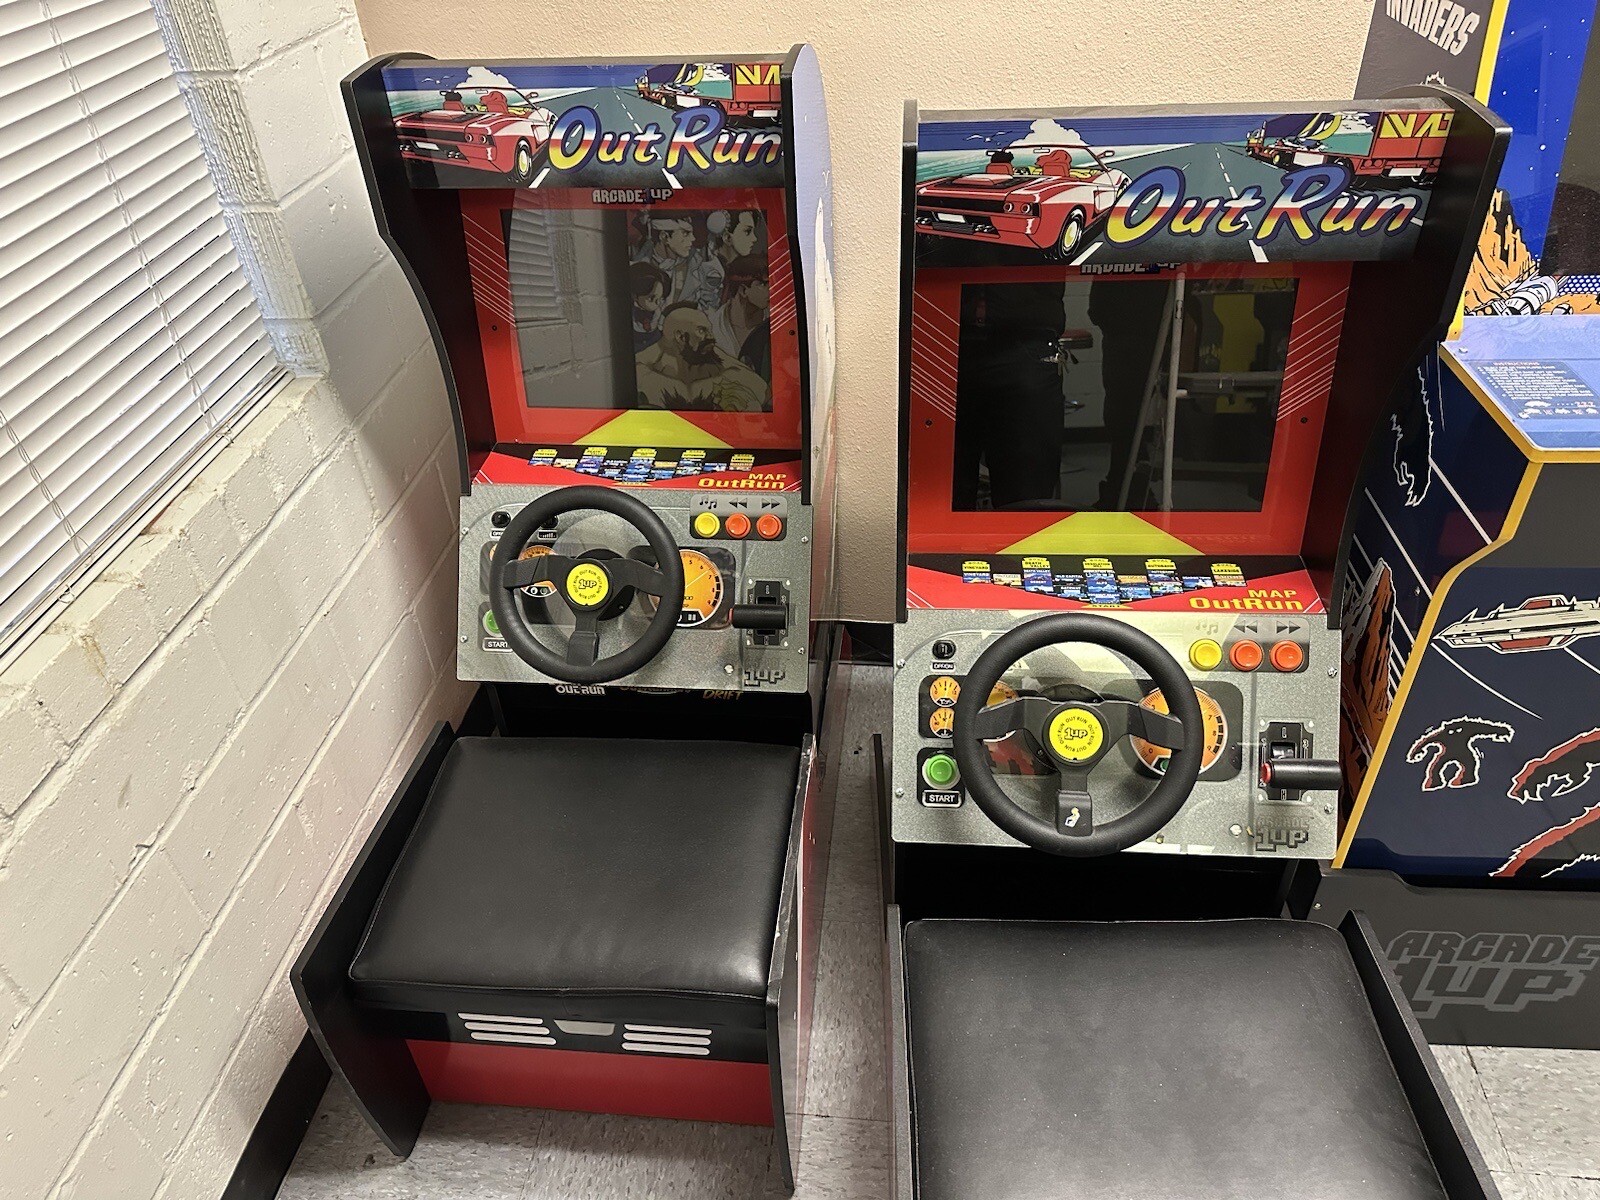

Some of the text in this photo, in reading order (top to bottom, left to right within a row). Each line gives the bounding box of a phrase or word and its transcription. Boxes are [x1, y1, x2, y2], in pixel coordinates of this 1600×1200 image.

[592, 189, 644, 204] ARCADE
[698, 478, 785, 489] OutRun
[578, 578, 597, 590] 1UP
[1248, 589, 1297, 598] MAP
[1189, 597, 1303, 610] OutRun
[488, 640, 508, 648] START
[702, 690, 744, 700] DRIFT
[1064, 727, 1089, 741] 1UP
[929, 795, 955, 803] START
[1256, 827, 1309, 852] 1UP
[1387, 931, 1600, 970] ARCADE
